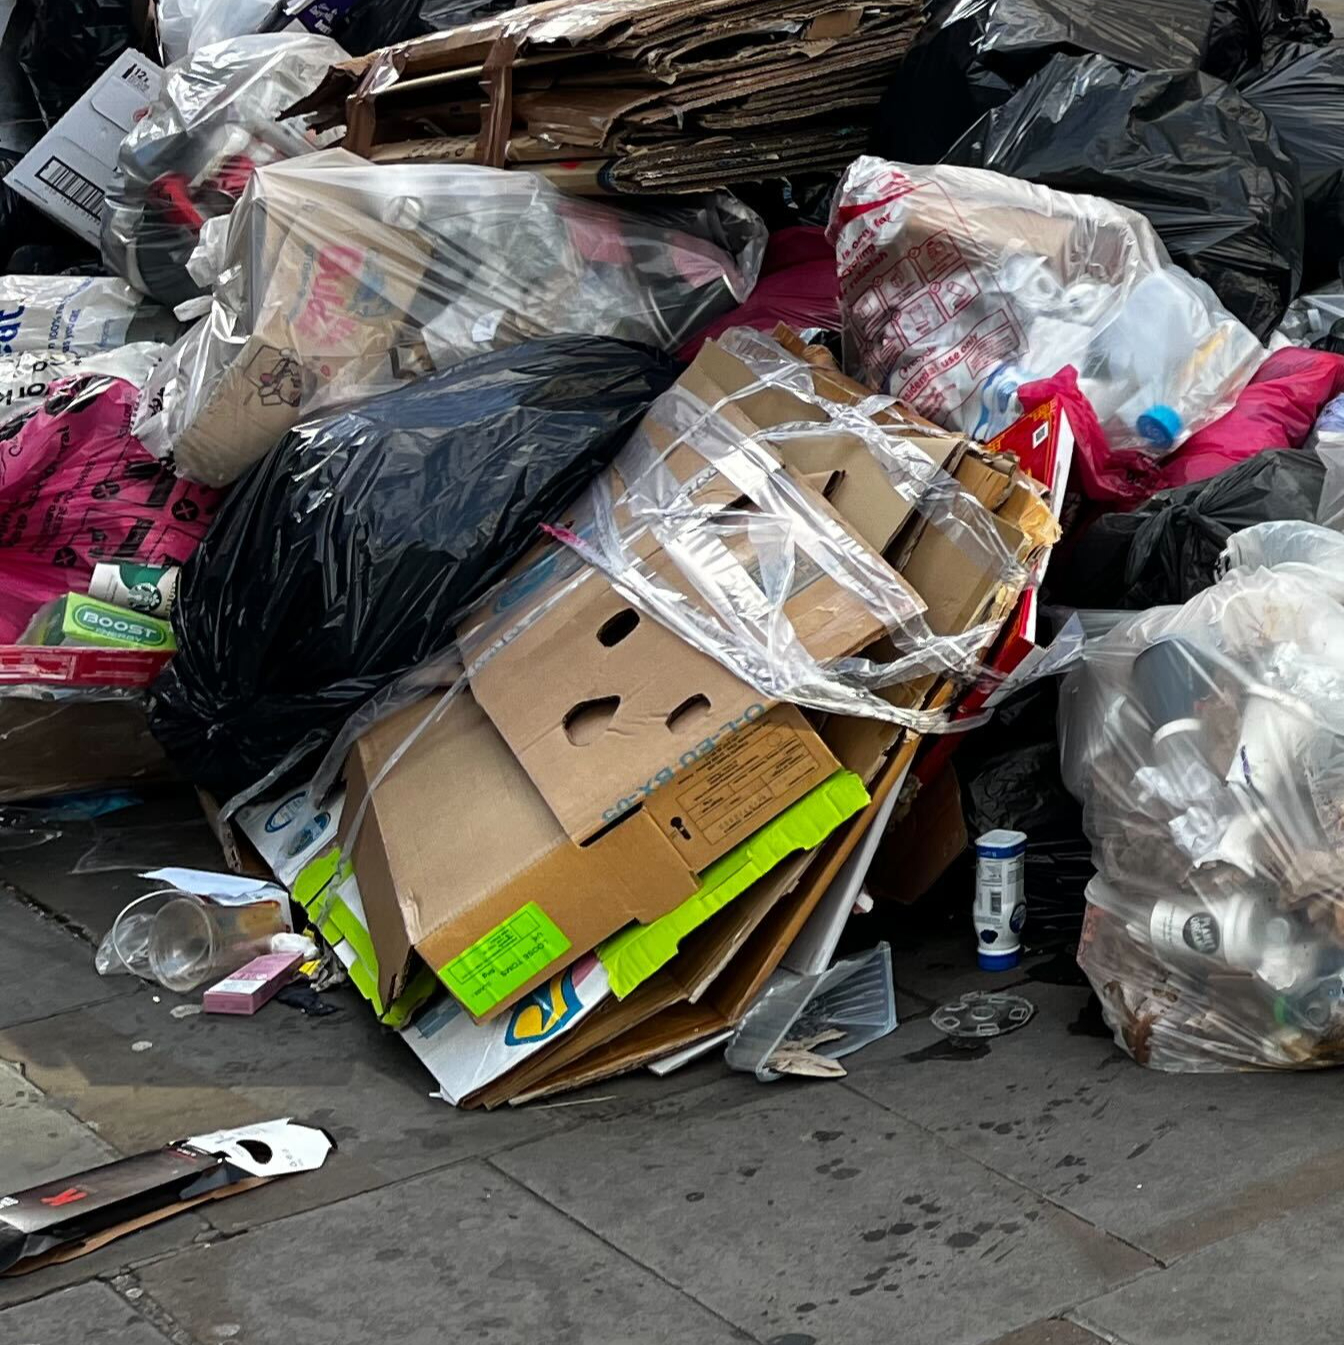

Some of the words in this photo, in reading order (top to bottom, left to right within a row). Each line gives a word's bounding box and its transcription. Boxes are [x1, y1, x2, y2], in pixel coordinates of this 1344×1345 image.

[940, 351, 961, 368] use
[960, 332, 979, 353] only
[82, 610, 157, 638] BOOST
[95, 627, 142, 642] ENERGY
